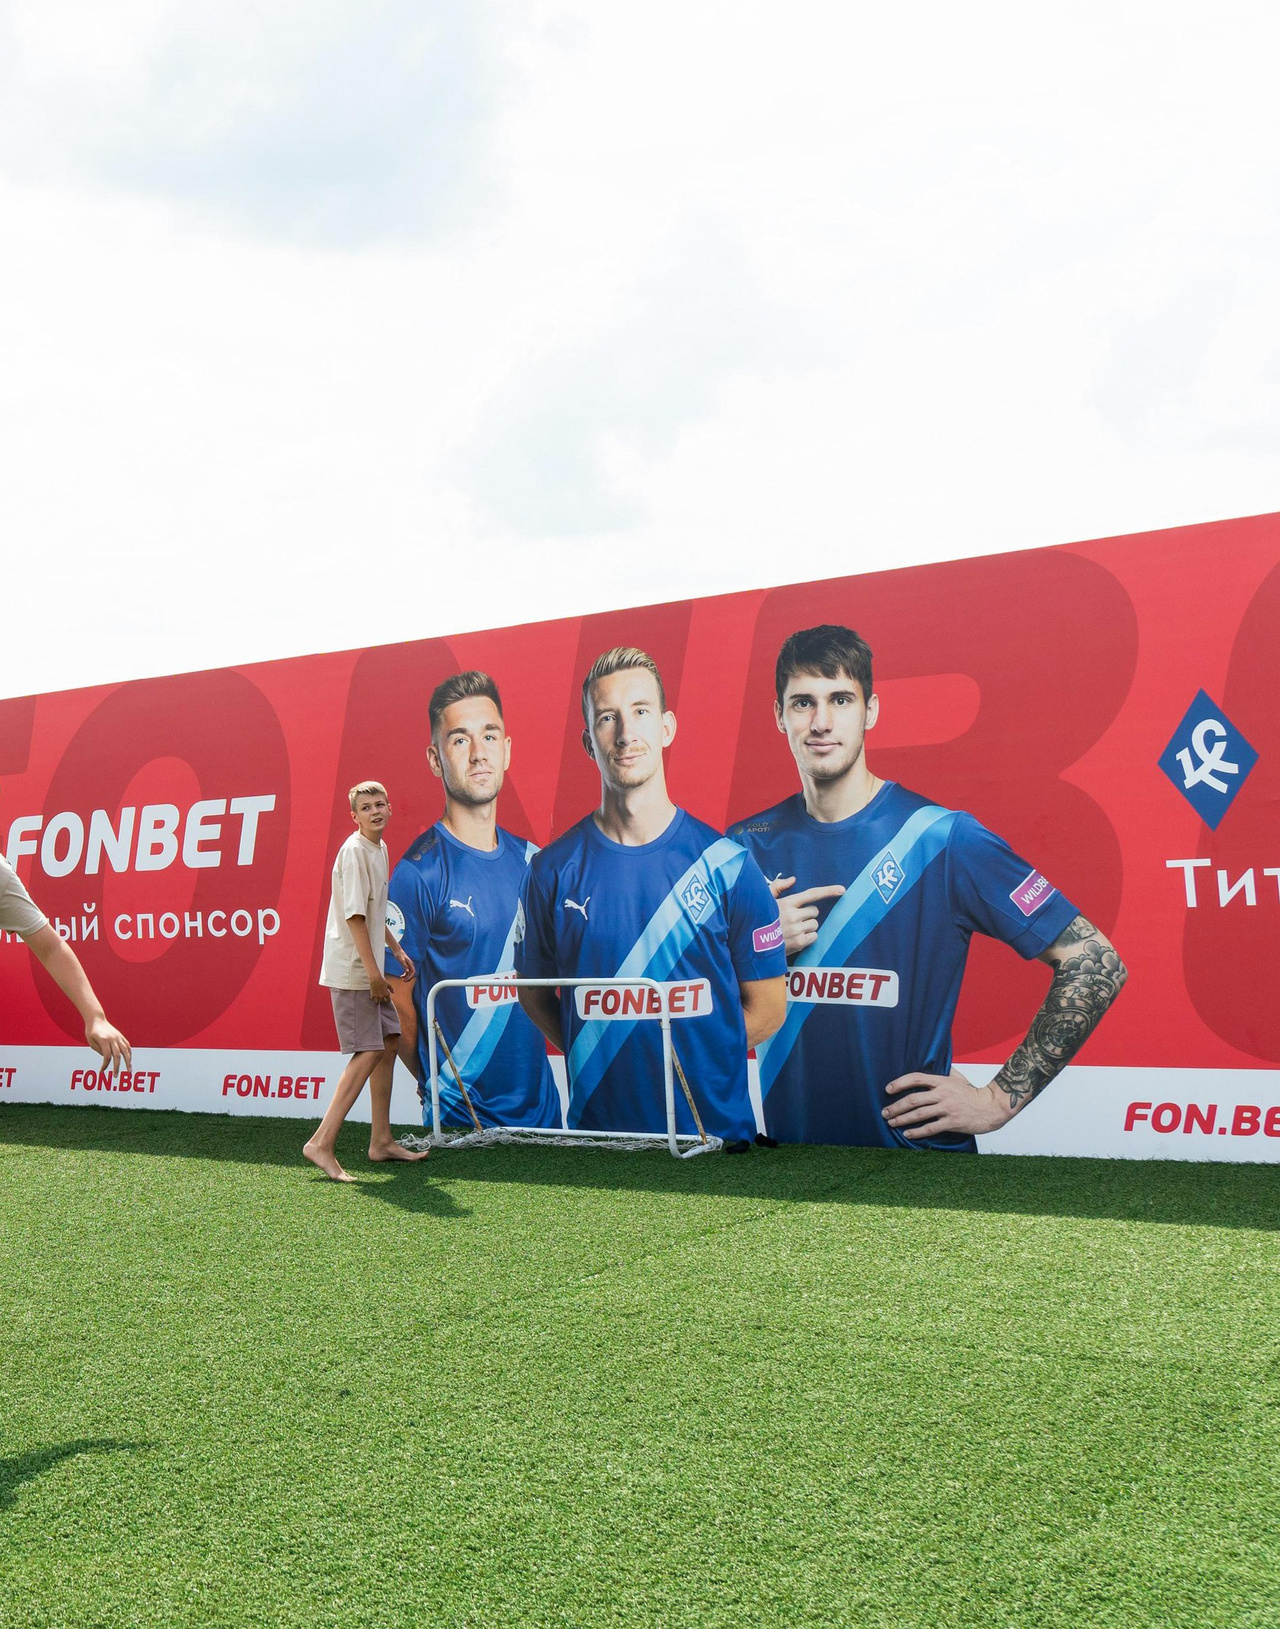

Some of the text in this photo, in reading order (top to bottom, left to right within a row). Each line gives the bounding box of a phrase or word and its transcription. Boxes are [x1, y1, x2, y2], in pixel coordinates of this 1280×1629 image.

[6, 794, 276, 877] FONBET
[114, 908, 280, 945] спонсор
[473, 974, 517, 1004] FON
[584, 983, 704, 1016] FONBET
[785, 971, 891, 1001] ONBET
[70, 1069, 161, 1093] FON.BET
[222, 1074, 325, 1099] FON.BET
